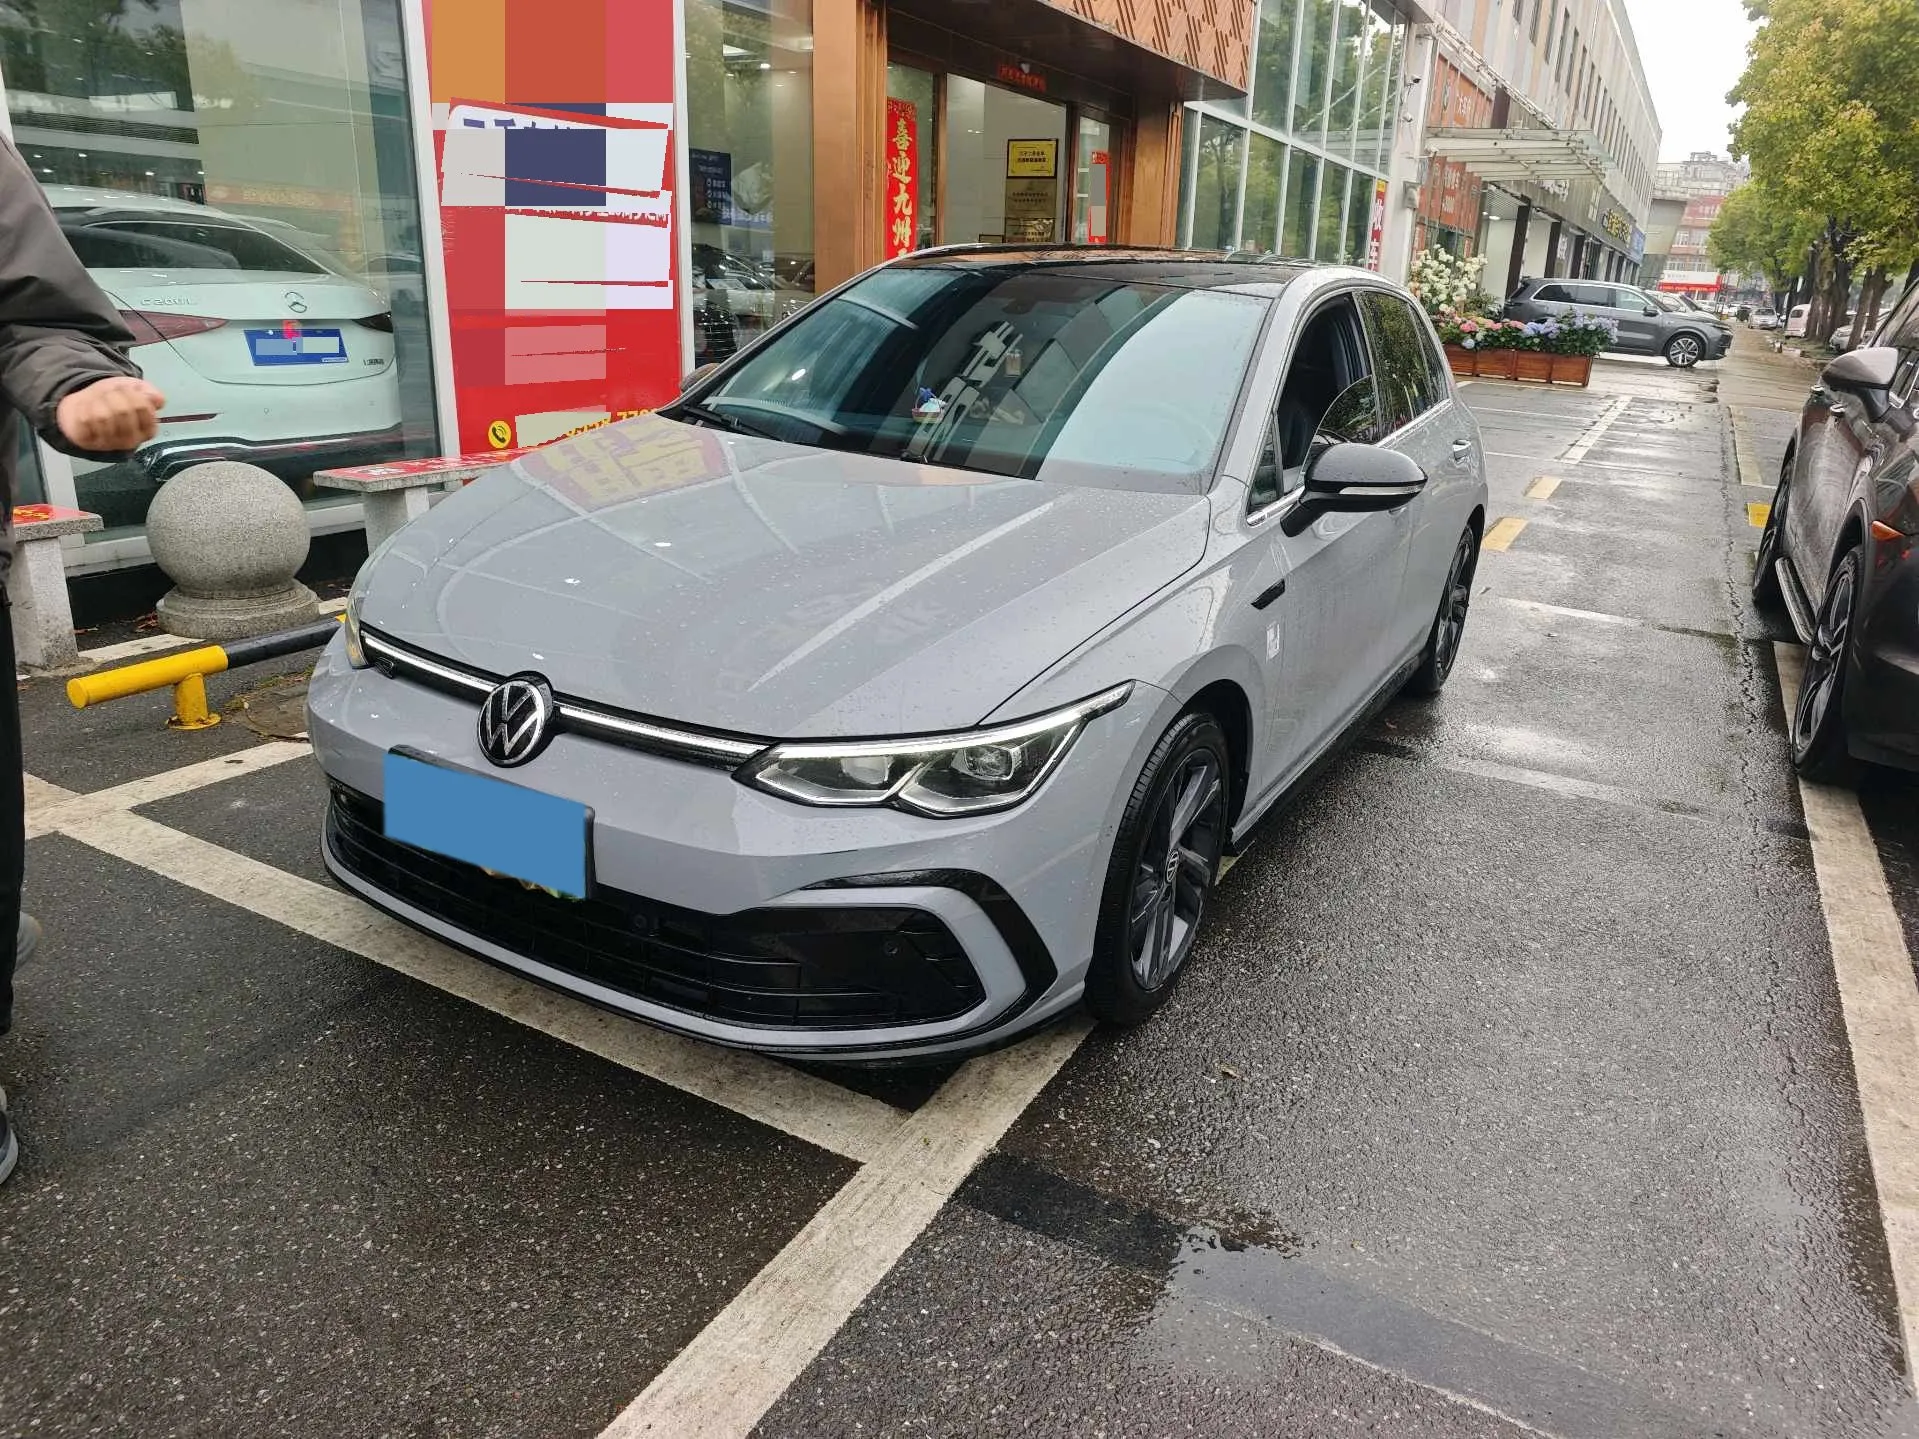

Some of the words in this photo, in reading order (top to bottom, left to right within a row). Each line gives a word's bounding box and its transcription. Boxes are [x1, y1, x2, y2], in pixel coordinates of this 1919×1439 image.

[892, 117, 913, 257] 喜迎九州
[484, 682, 541, 761] VW
